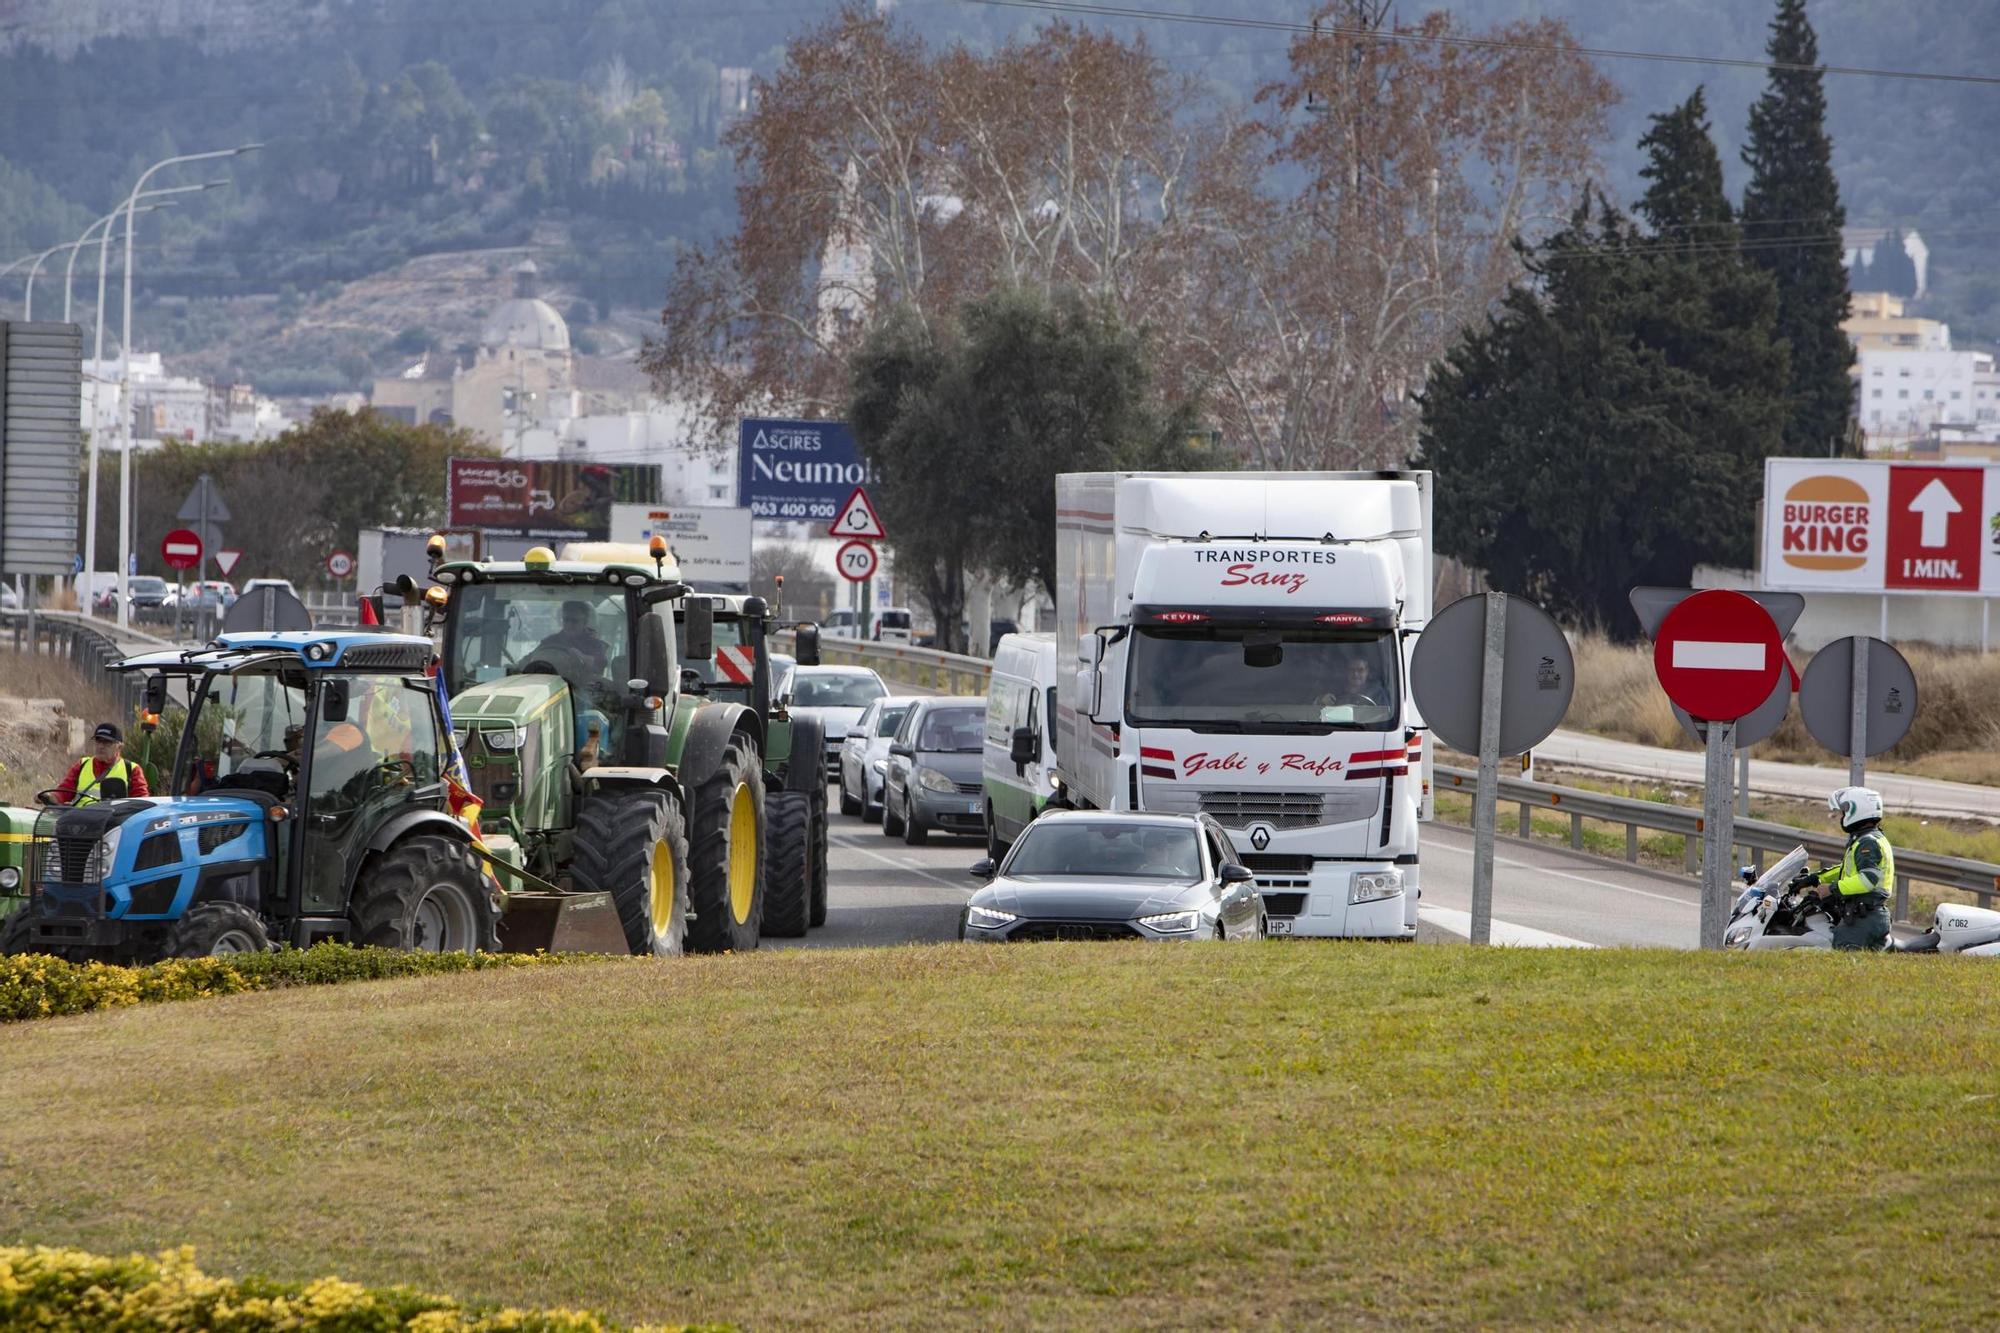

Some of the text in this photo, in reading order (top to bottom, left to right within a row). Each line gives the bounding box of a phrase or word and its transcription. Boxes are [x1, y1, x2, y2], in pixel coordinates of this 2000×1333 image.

[752, 453, 880, 484] Neumol
[751, 502, 835, 517] 963 400 900
[1783, 504, 1869, 525] BURGER
[1782, 525, 1868, 553] KING
[332, 559, 347, 569] 40
[846, 554, 867, 569] 70
[1194, 550, 1336, 565] TRANSPORTES
[1903, 558, 1963, 579] 1 MIN.
[1220, 563, 1308, 593] Sanz
[1162, 613, 1201, 621] KEVIN
[1324, 615, 1364, 623] ARANTXA
[1182, 751, 1343, 776] Gabi y Rafa
[153, 814, 198, 830] LADINI
[1270, 922, 1292, 933] HPJ
[1954, 919, 1969, 928] 062
